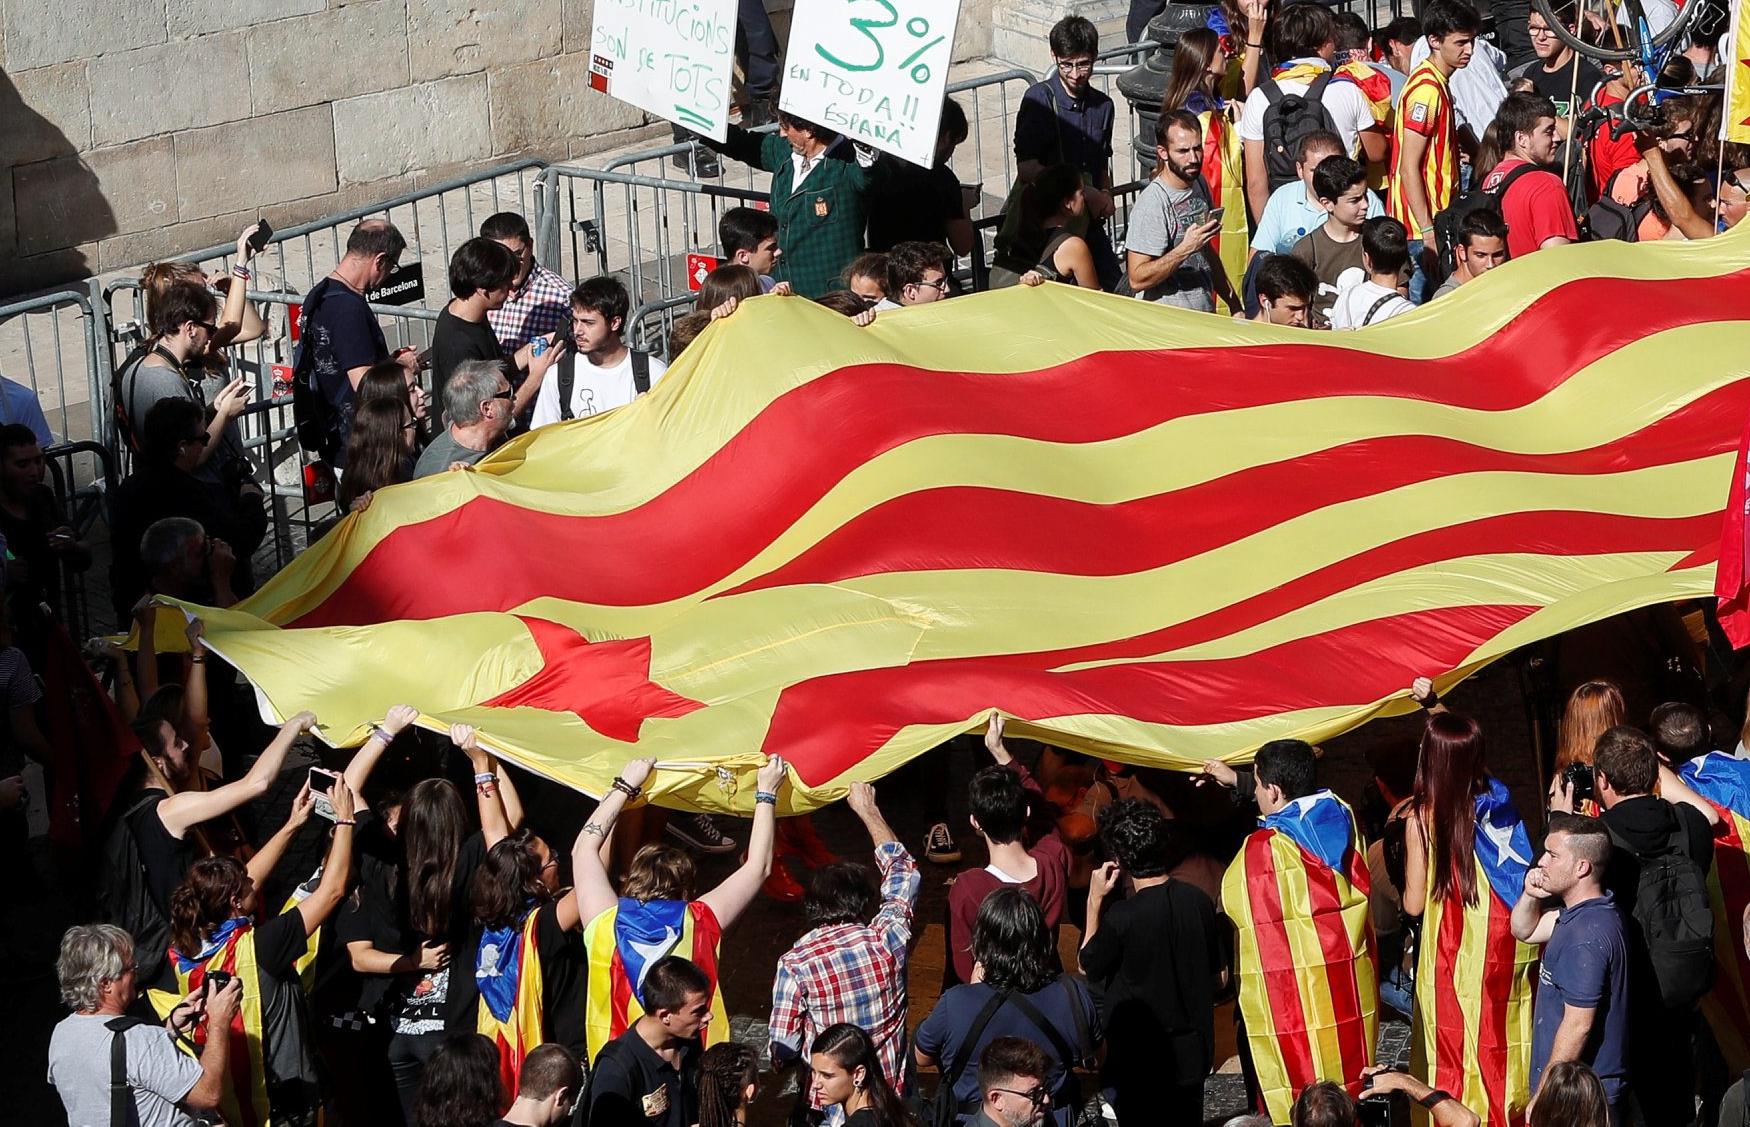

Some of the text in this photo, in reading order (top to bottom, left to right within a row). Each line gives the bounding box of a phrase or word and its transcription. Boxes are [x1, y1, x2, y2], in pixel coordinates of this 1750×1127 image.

[596, 26, 629, 60] SON
[663, 53, 723, 111] TOTS
[789, 63, 810, 84] EN
[823, 102, 904, 150] ESPAÑA
[370, 291, 380, 301] de
[380, 279, 418, 298] Barcelona
